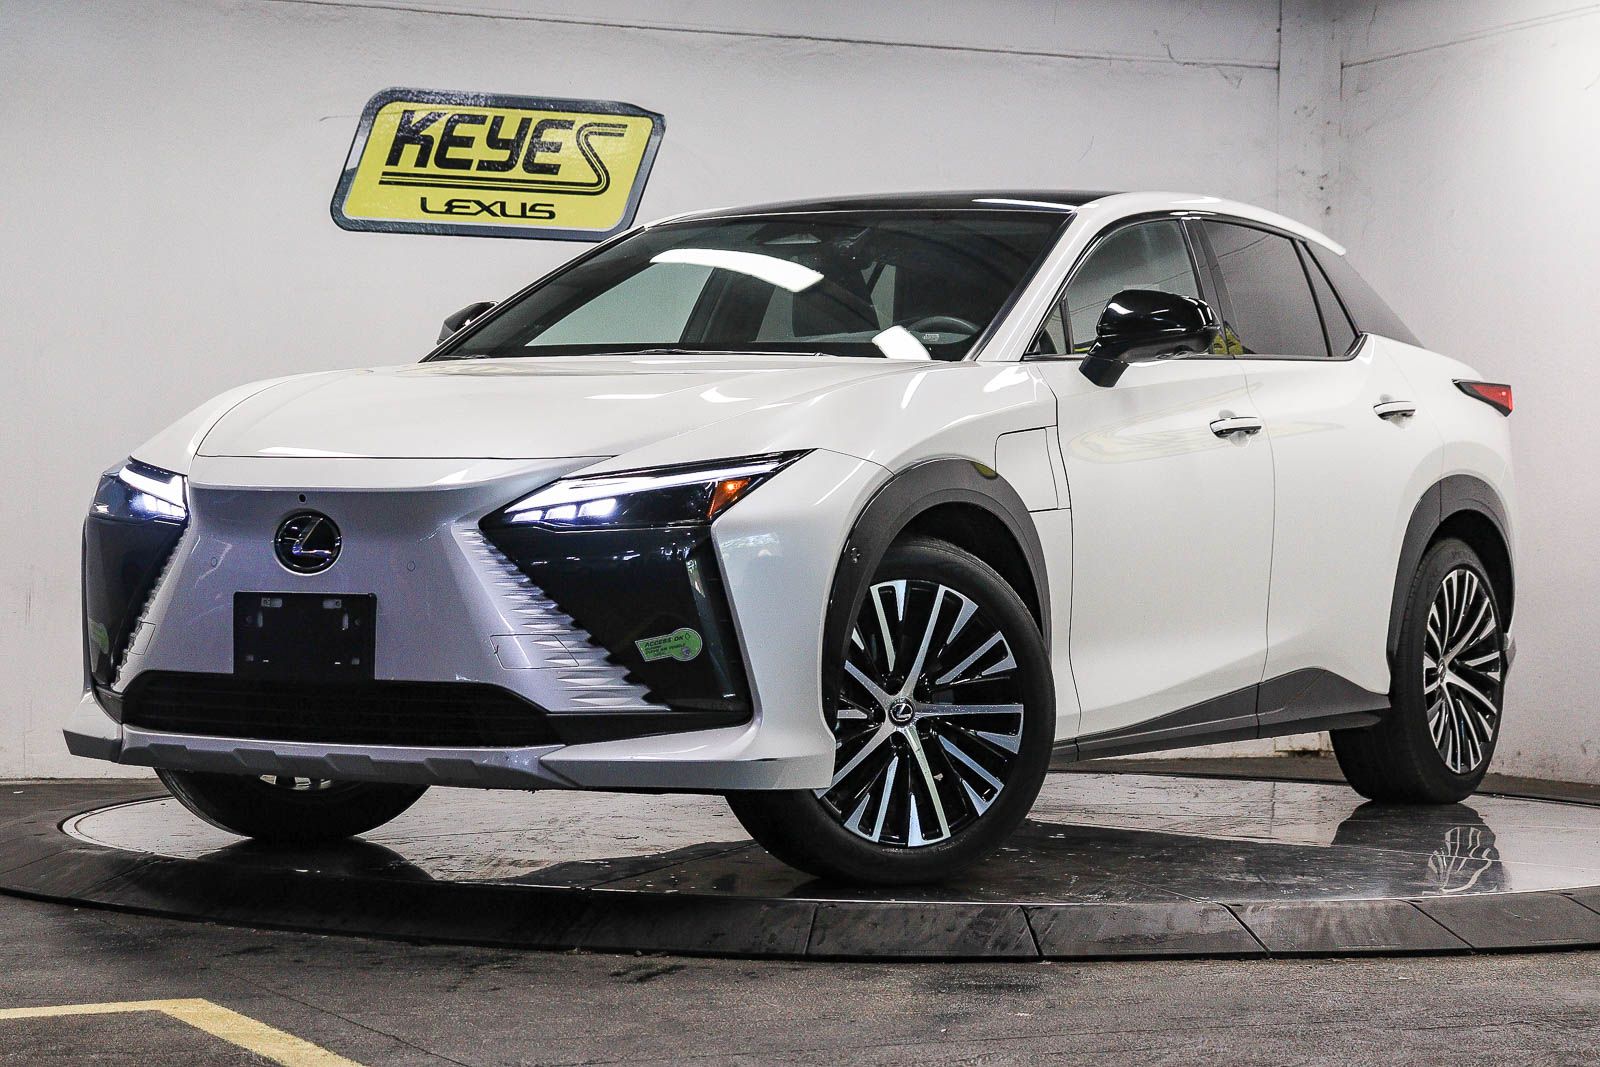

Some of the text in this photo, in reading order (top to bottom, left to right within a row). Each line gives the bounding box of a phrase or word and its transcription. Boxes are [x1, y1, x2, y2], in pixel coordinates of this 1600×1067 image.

[382, 109, 628, 196] KEYES
[420, 196, 556, 220] LEXUS
[644, 636, 672, 648] ACCESS
